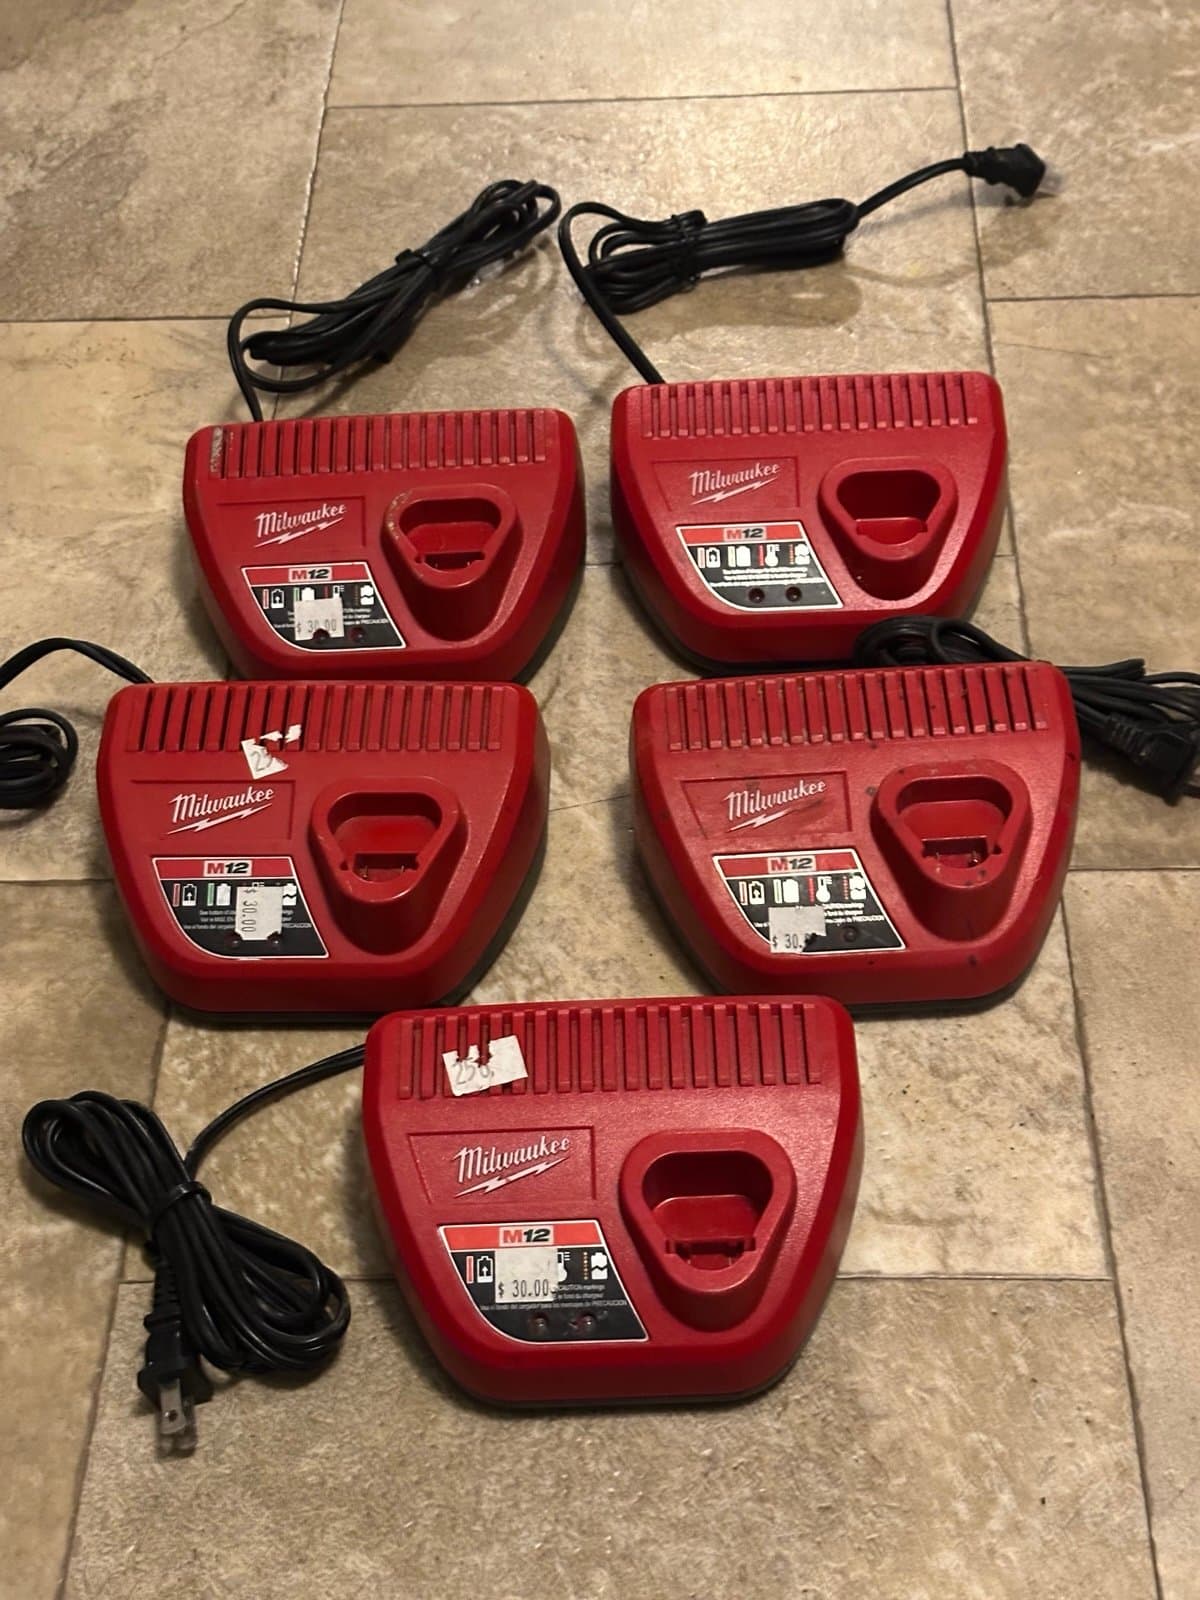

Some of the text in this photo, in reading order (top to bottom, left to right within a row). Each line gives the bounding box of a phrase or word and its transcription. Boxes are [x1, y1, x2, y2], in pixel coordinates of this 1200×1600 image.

[688, 463, 782, 497] Milwaukee
[254, 503, 346, 538] Milwaukee
[726, 528, 764, 540] M12
[291, 568, 330, 581] M12
[168, 786, 275, 823] Milwaukee
[722, 779, 827, 821] Milwaukee
[206, 861, 249, 875] M12
[770, 858, 813, 871] M12
[241, 900, 258, 933] 30.00
[785, 932, 811, 949] 30.
[453, 1135, 571, 1183] Milwaukee
[503, 1227, 551, 1244] M12
[498, 1281, 505, 1298] $
[512, 1278, 549, 1298] 30.00
